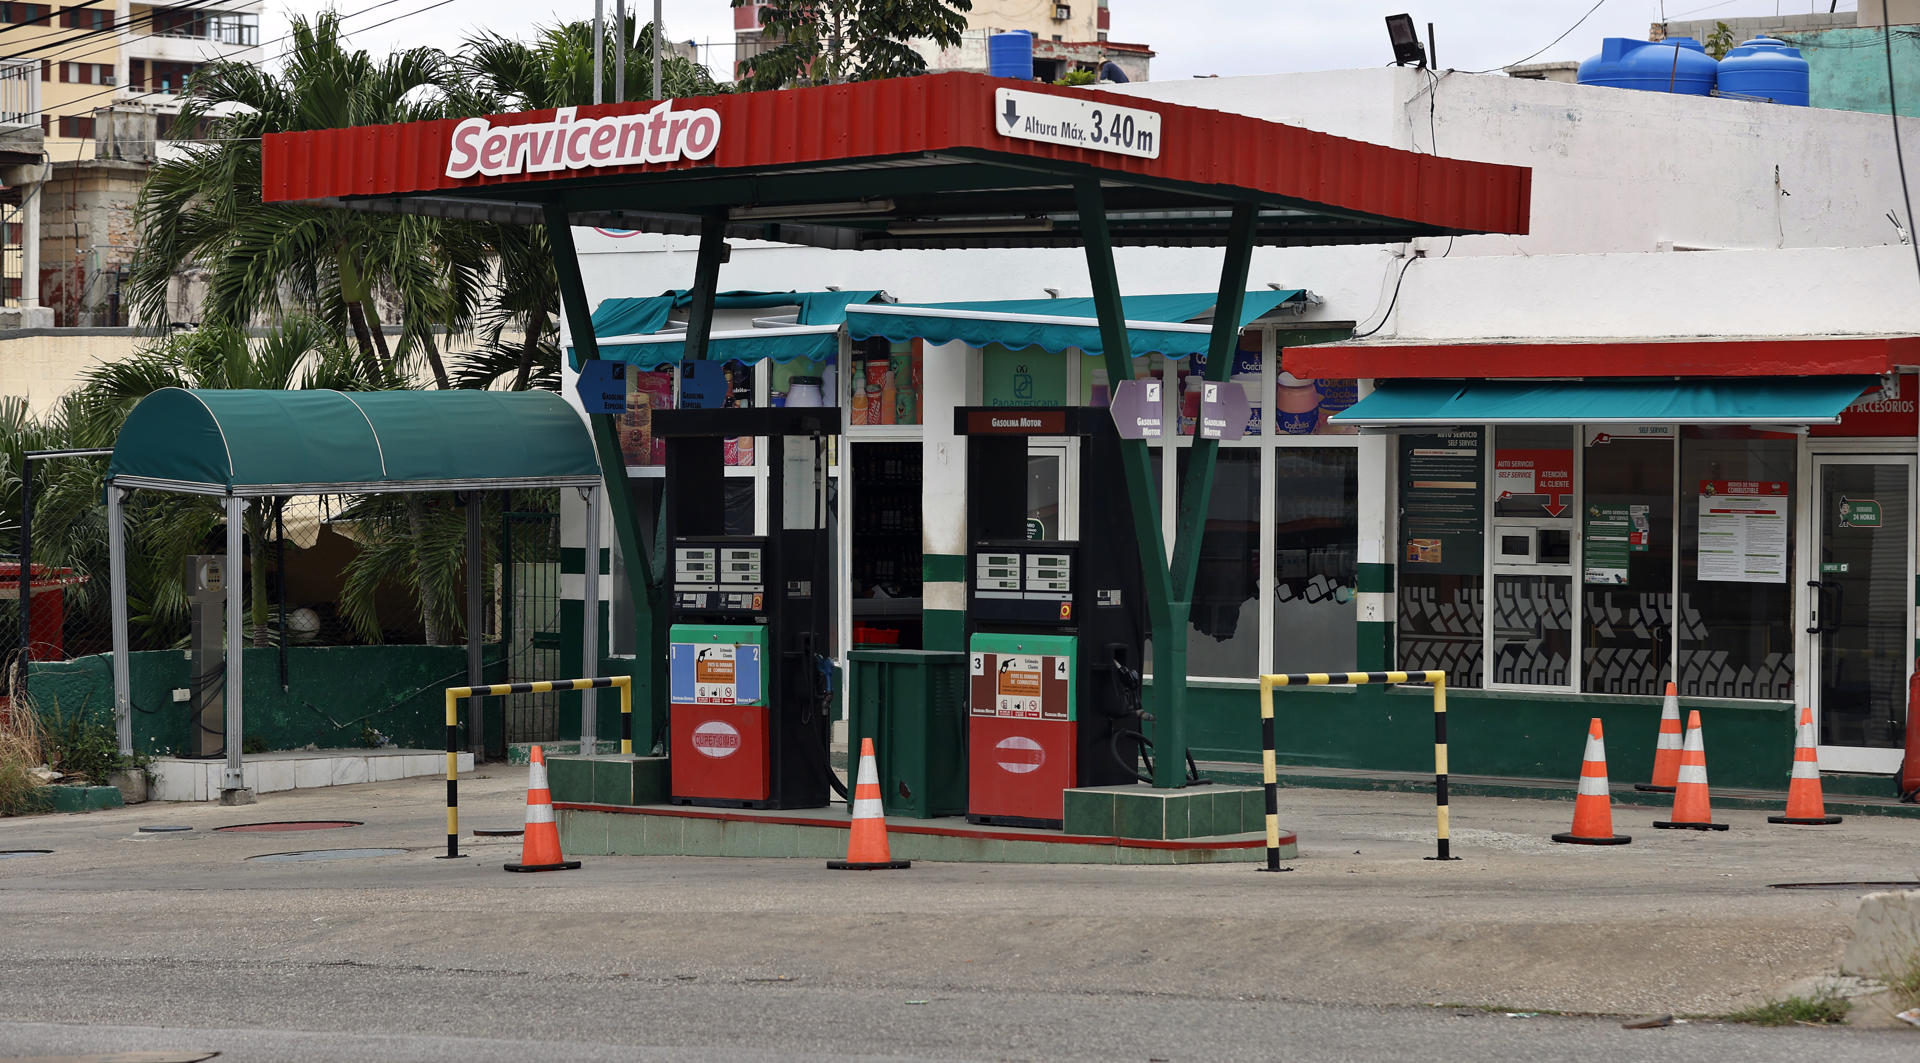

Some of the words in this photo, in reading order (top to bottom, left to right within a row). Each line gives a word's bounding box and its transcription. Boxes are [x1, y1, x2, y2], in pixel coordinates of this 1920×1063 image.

[1024, 115, 1057, 137] Altura
[1060, 121, 1087, 142] Máx.
[1090, 109, 1135, 149] 3.40
[1137, 129, 1153, 152] m
[448, 106, 718, 175] Servicentro
[1857, 400, 1915, 413] ACCESORIOS
[992, 417, 1019, 427] GASOLINA
[1020, 417, 1042, 428] MOTOR
[1137, 417, 1161, 426] GASOLINA
[1203, 417, 1227, 427] GASOLINA
[1142, 427, 1161, 436] MOTOR
[1203, 427, 1221, 437] MOTOR
[753, 647, 758, 661] 2
[974, 657, 981, 669] 3
[1057, 661, 1065, 673] 4
